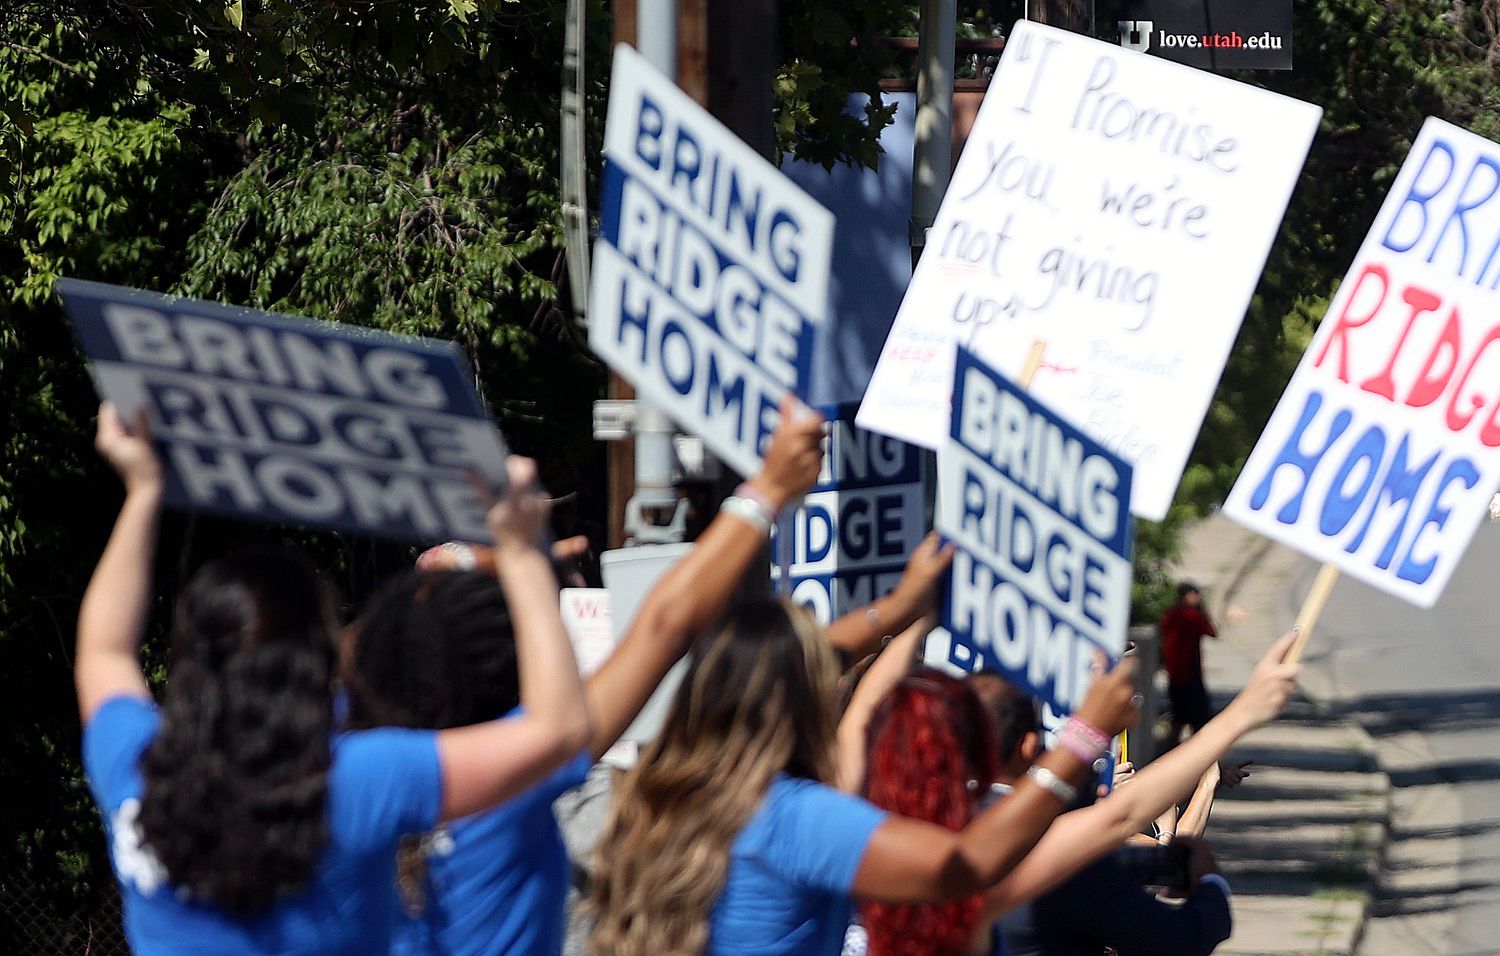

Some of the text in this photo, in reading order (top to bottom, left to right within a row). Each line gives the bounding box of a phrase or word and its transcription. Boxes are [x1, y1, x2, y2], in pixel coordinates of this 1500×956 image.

[1159, 30, 1282, 49] love.utah.edu
[636, 92, 803, 283] BRING
[1100, 176, 1209, 239] we're
[617, 178, 798, 388] RIDGE
[940, 213, 1160, 332] not giving
[103, 304, 449, 409] BRING
[144, 373, 470, 470] RIDGE
[817, 420, 906, 485] ING
[960, 366, 1119, 541] BRING
[170, 443, 496, 544] HOME
[790, 492, 905, 564] DGE
[1250, 391, 1481, 585] HOME
[962, 467, 1106, 629] RIDGE
